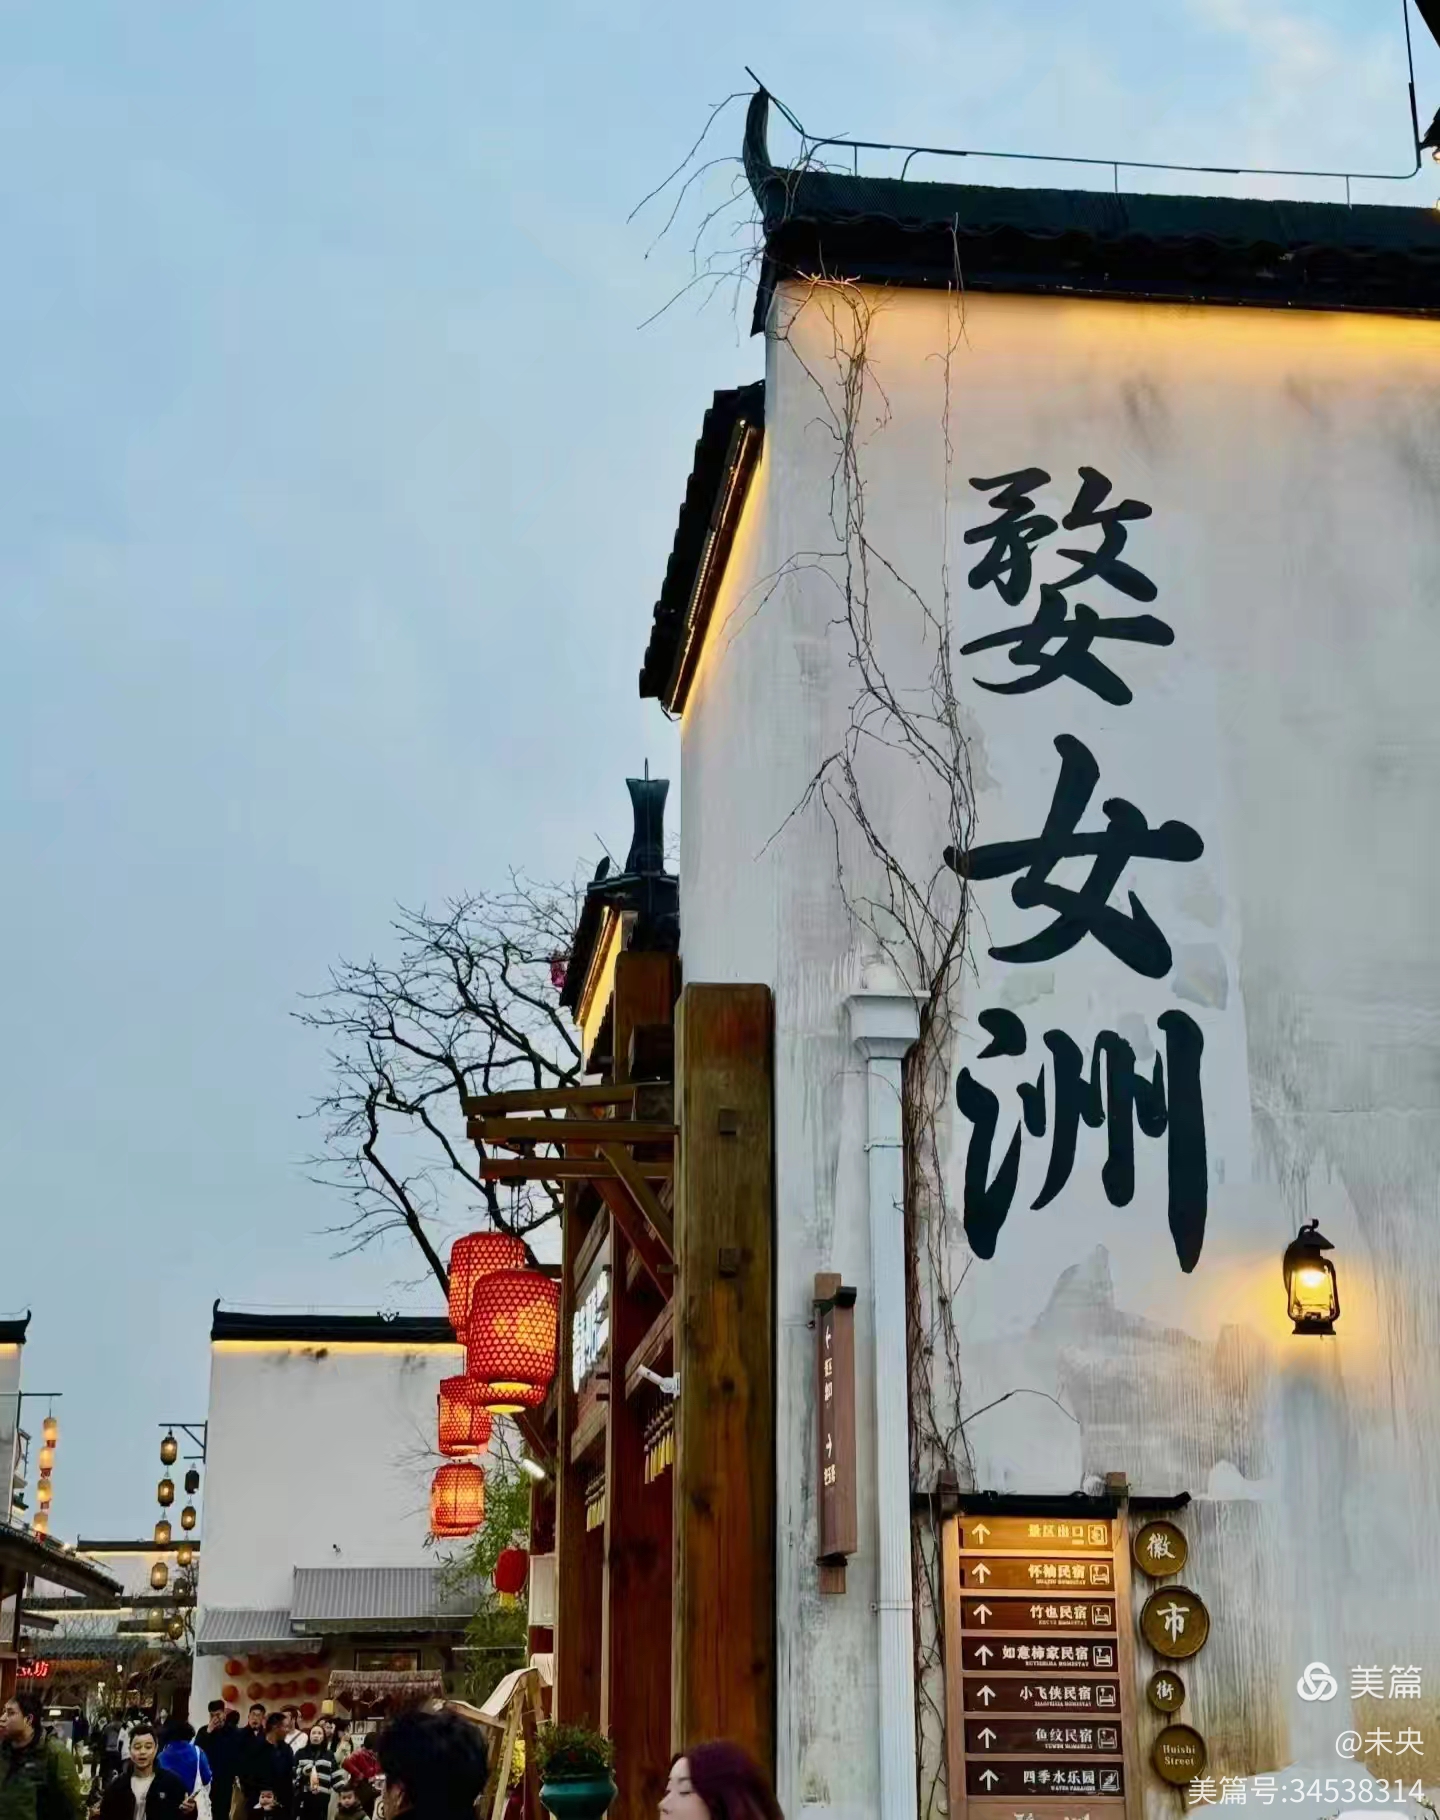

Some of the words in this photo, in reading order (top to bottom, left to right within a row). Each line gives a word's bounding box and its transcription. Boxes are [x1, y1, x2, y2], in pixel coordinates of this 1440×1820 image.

[943, 466, 1209, 1274] 婺女洲
[1028, 1523, 1084, 1538] 景区出口
[1147, 1532, 1176, 1560] 徽
[1029, 1603, 1088, 1620] 竹也民宿
[1156, 1602, 1190, 1644] 市
[1002, 1644, 1089, 1660] 如意柿家民宿
[1019, 1685, 1092, 1701] 小飞侠民宿
[1035, 1727, 1093, 1743] 鱼纹民宿
[1163, 1744, 1196, 1755] Huishi
[1164, 1757, 1195, 1767] Street
[1023, 1769, 1095, 1785] 四季水乐园
